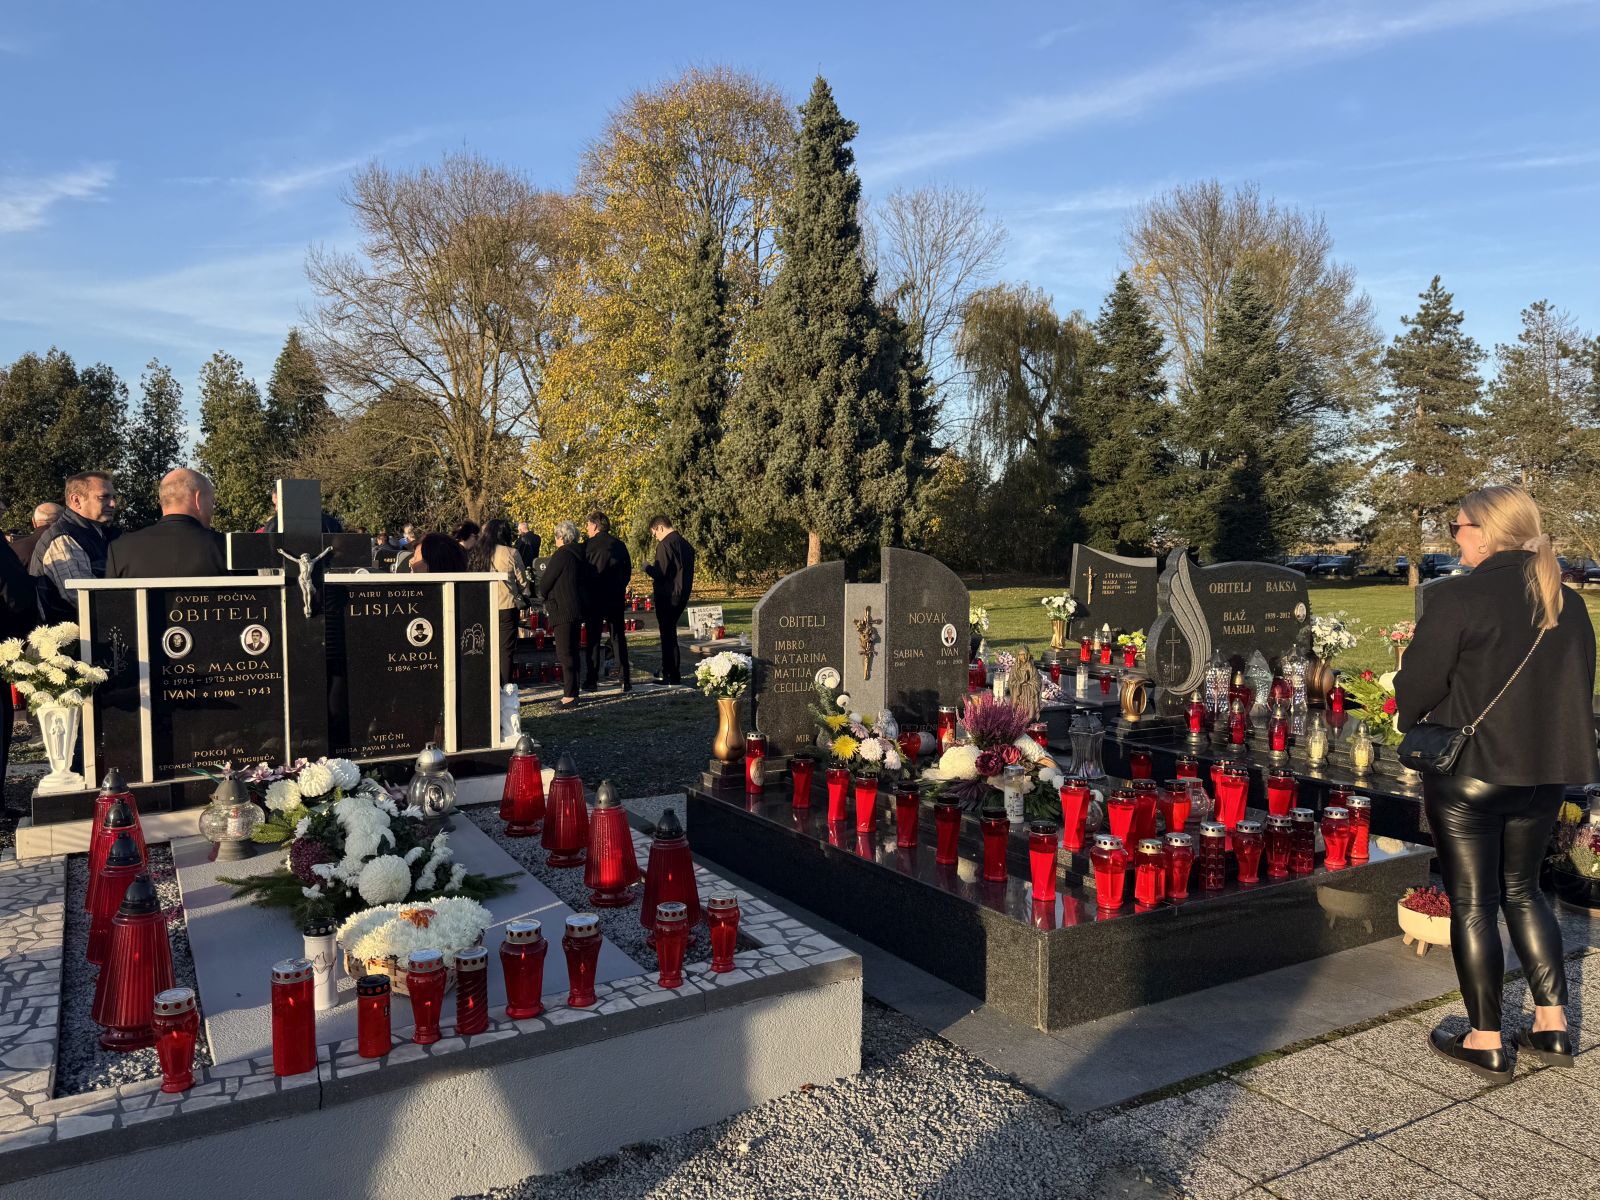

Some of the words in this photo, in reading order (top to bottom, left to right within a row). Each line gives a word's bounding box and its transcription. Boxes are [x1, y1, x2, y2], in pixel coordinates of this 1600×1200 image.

[1208, 581, 1252, 594] OBITELJ
[1265, 580, 1297, 593] BAKSA
[175, 595, 209, 603] OVDJE
[217, 592, 257, 602] POČIVA
[349, 591, 355, 599] U
[387, 589, 424, 598] BOŽJEM
[169, 606, 268, 622] OBITELJ
[350, 602, 419, 618] LISJAK
[1223, 609, 1247, 622] BLAŽ
[779, 615, 826, 628] OBITELJ
[909, 612, 947, 624] NOVAK
[1222, 624, 1256, 635] MARIJA
[775, 640, 805, 651] IMBRO
[388, 651, 437, 662] KAROL
[893, 648, 924, 659] SABINA
[941, 647, 959, 657] IVAN
[774, 653, 827, 664] KATARINA
[162, 663, 196, 675] KOS
[208, 660, 270, 672] MAGDA
[395, 664, 411, 672] 1896
[774, 668, 812, 679] MATIJA
[163, 688, 196, 700] IVAN
[214, 689, 235, 698] 1900
[247, 686, 271, 696] 1943
[773, 682, 815, 693] CECILIJA
[373, 732, 404, 743] VJEČNI
[795, 733, 810, 743] MIR
[194, 749, 227, 758] POKOJ
[232, 747, 245, 755] IM
[362, 744, 386, 752] PAVAO
